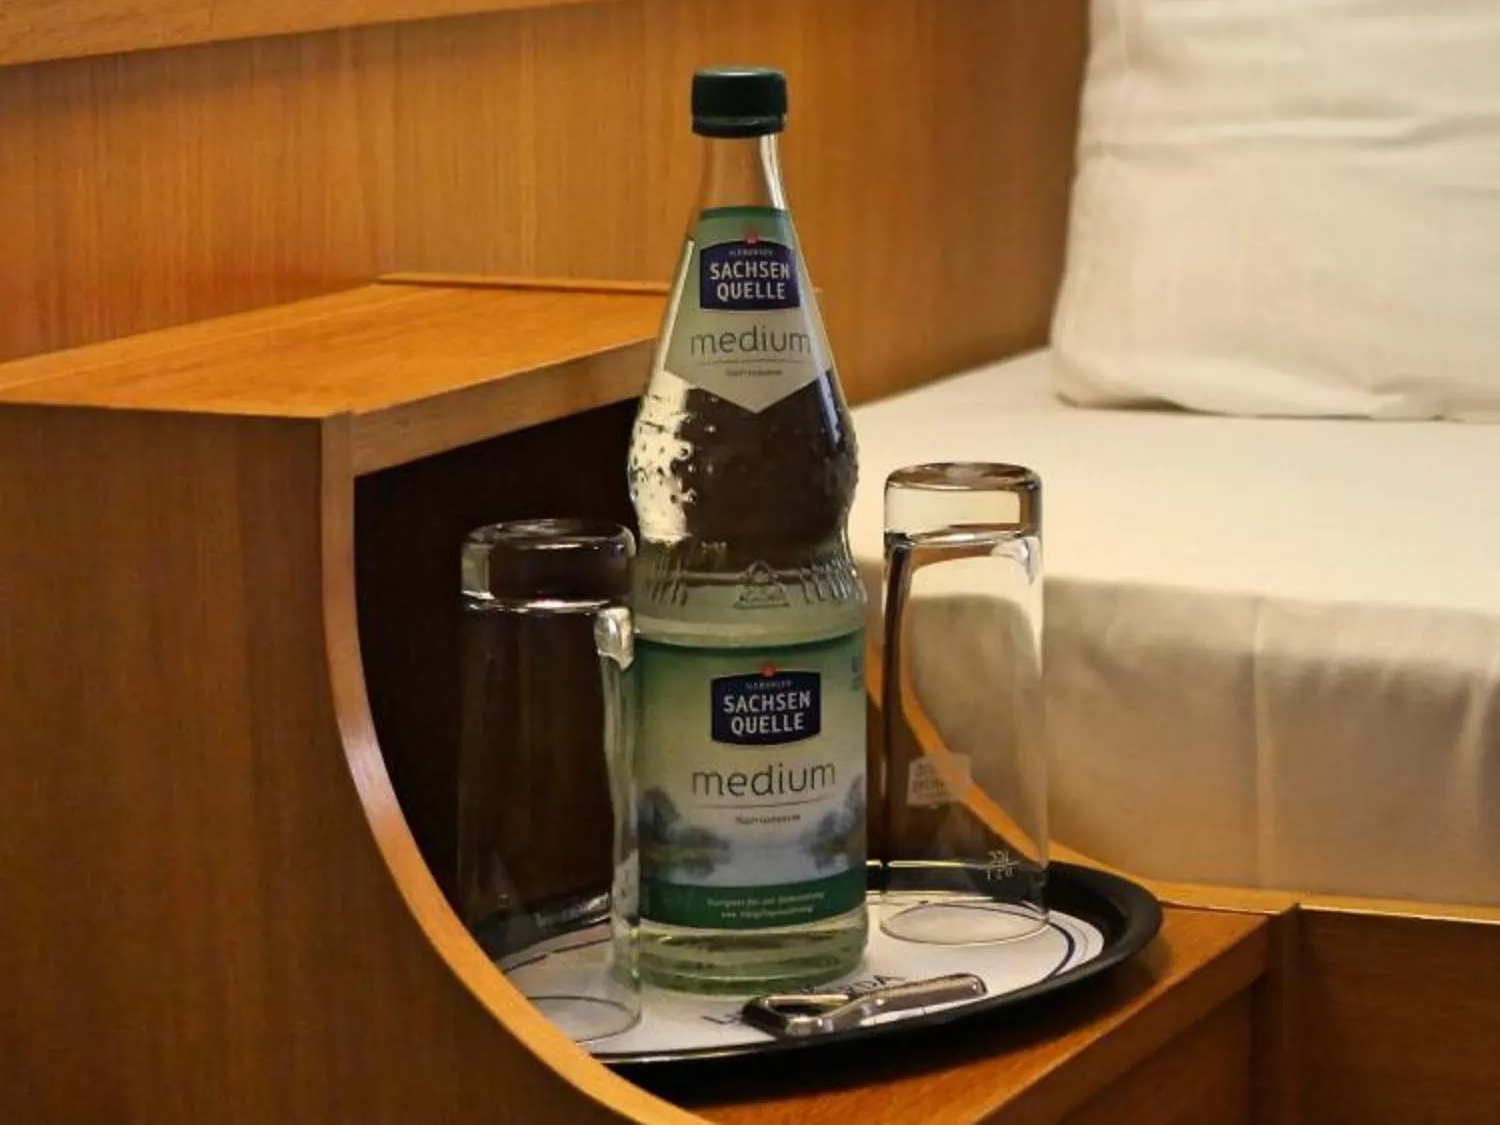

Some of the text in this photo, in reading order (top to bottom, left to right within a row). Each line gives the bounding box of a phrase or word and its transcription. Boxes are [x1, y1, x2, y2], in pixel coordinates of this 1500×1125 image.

[709, 260, 790, 280] SACHSEN
[717, 282, 786, 302] QUELLE
[691, 324, 811, 355] medium
[723, 691, 811, 713] SACHSEN
[731, 713, 804, 735] QUELLE
[692, 763, 836, 796] medium
